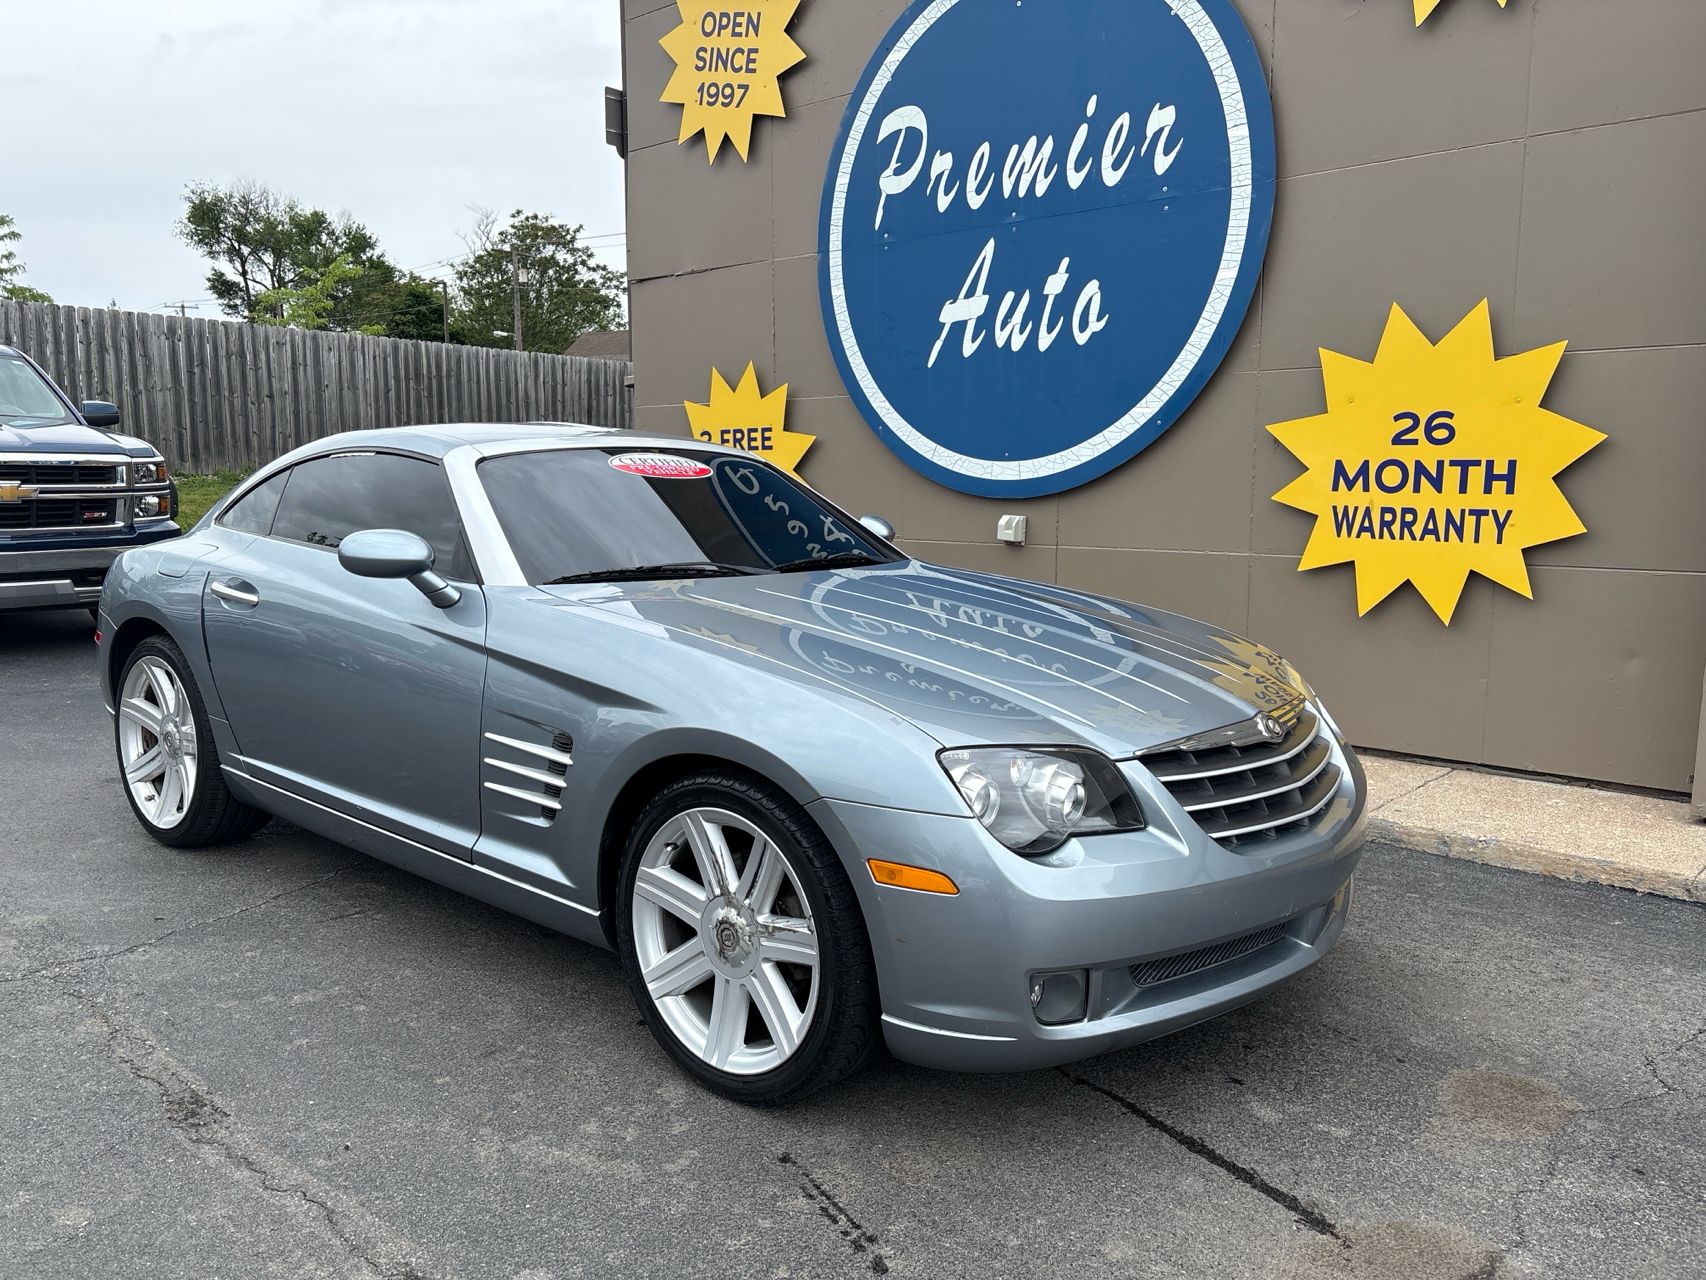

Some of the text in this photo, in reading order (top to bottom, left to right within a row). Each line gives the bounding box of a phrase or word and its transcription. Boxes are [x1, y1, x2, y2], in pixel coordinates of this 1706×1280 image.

[700, 11, 762, 38] OPEN
[694, 46, 760, 74] SINCE
[696, 81, 750, 109] 1997
[874, 94, 1184, 231] Premier
[927, 236, 1109, 369] Auto
[720, 427, 773, 451] FREE
[1390, 410, 1457, 446] 26
[1330, 458, 1518, 496] MONTH
[1331, 504, 1514, 545] WARRANTY
